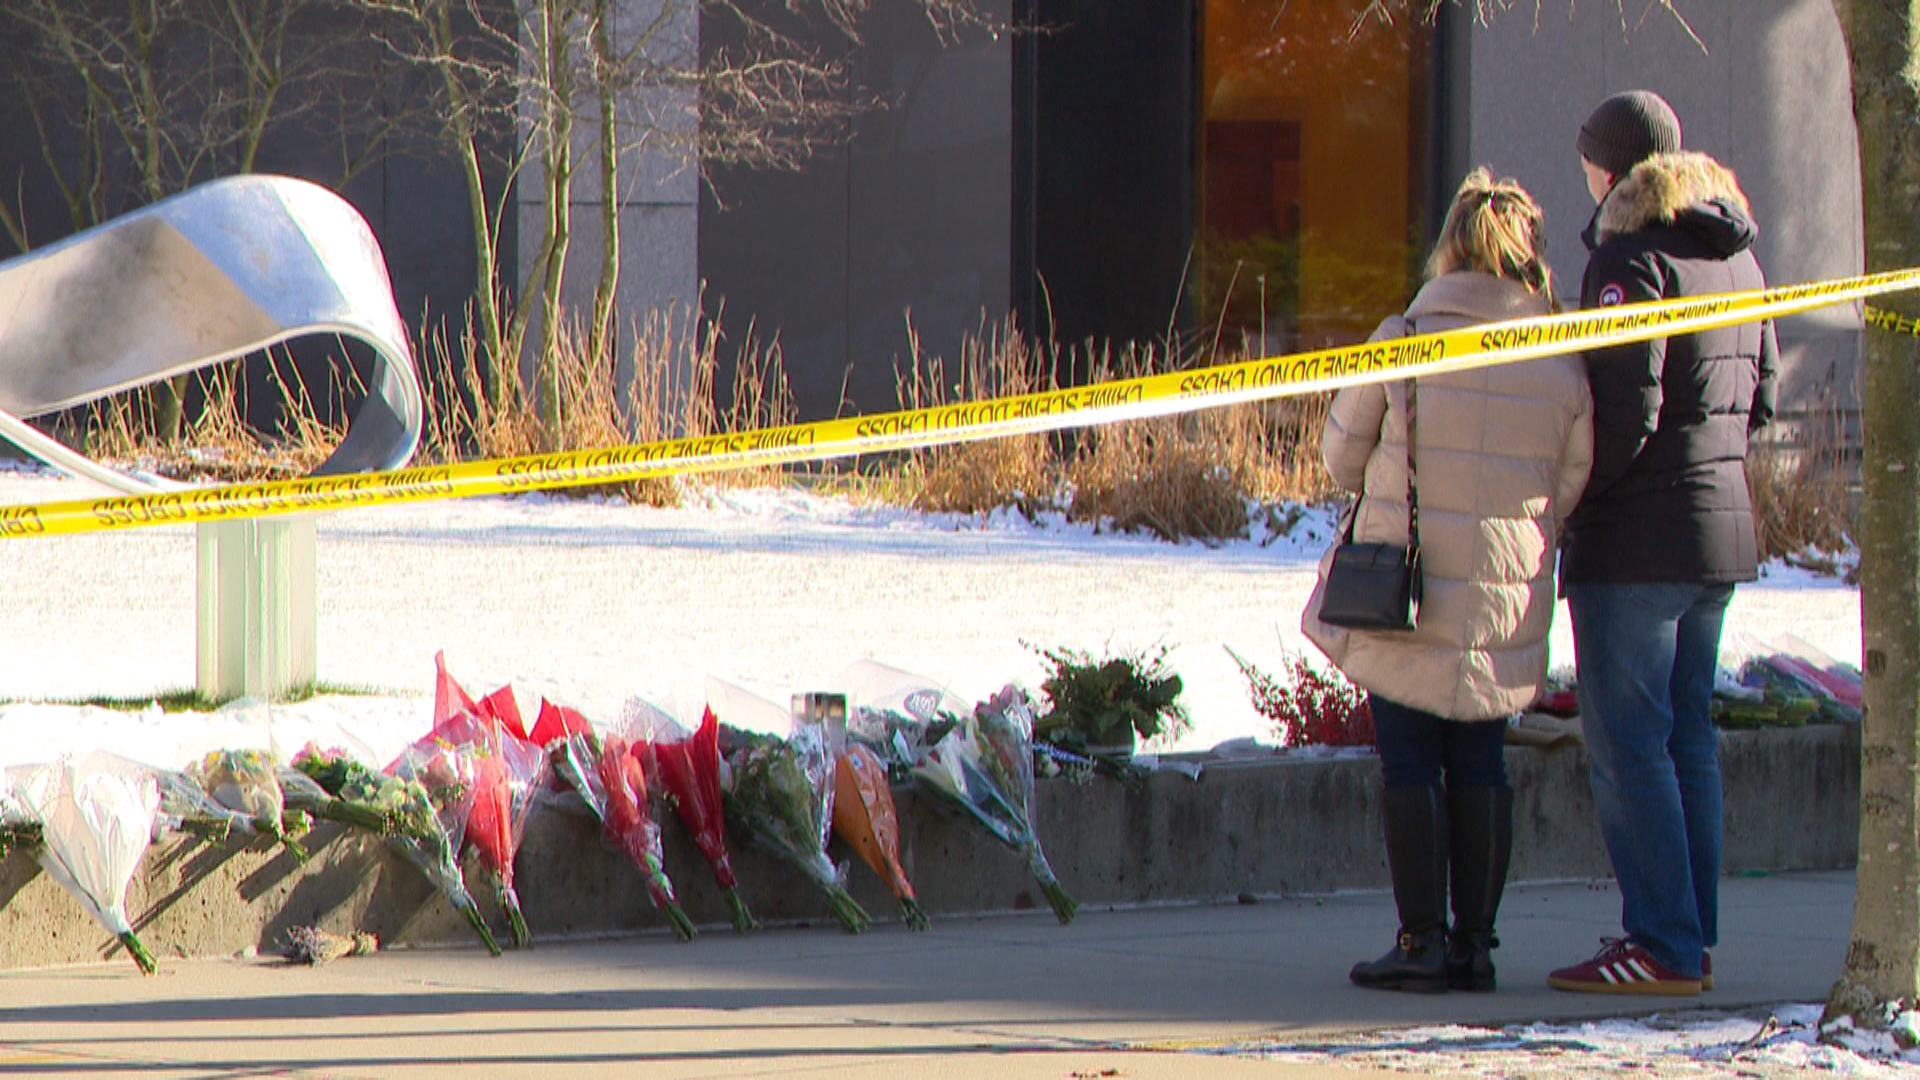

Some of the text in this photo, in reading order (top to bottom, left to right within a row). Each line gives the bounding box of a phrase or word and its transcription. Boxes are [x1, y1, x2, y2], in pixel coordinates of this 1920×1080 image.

[1480, 325, 1544, 351] CROSS
[1180, 339, 1446, 396] CRIME SCENE DO NOT CROSS
[856, 385, 1143, 438] CRIME SCENE DO NOT CROSS
[496, 428, 817, 487] CRIME SCENE DO NOT CROSS
[0, 506, 45, 537] CRI
[93, 469, 454, 527] CRIME SCENE DO NOT CROSS
